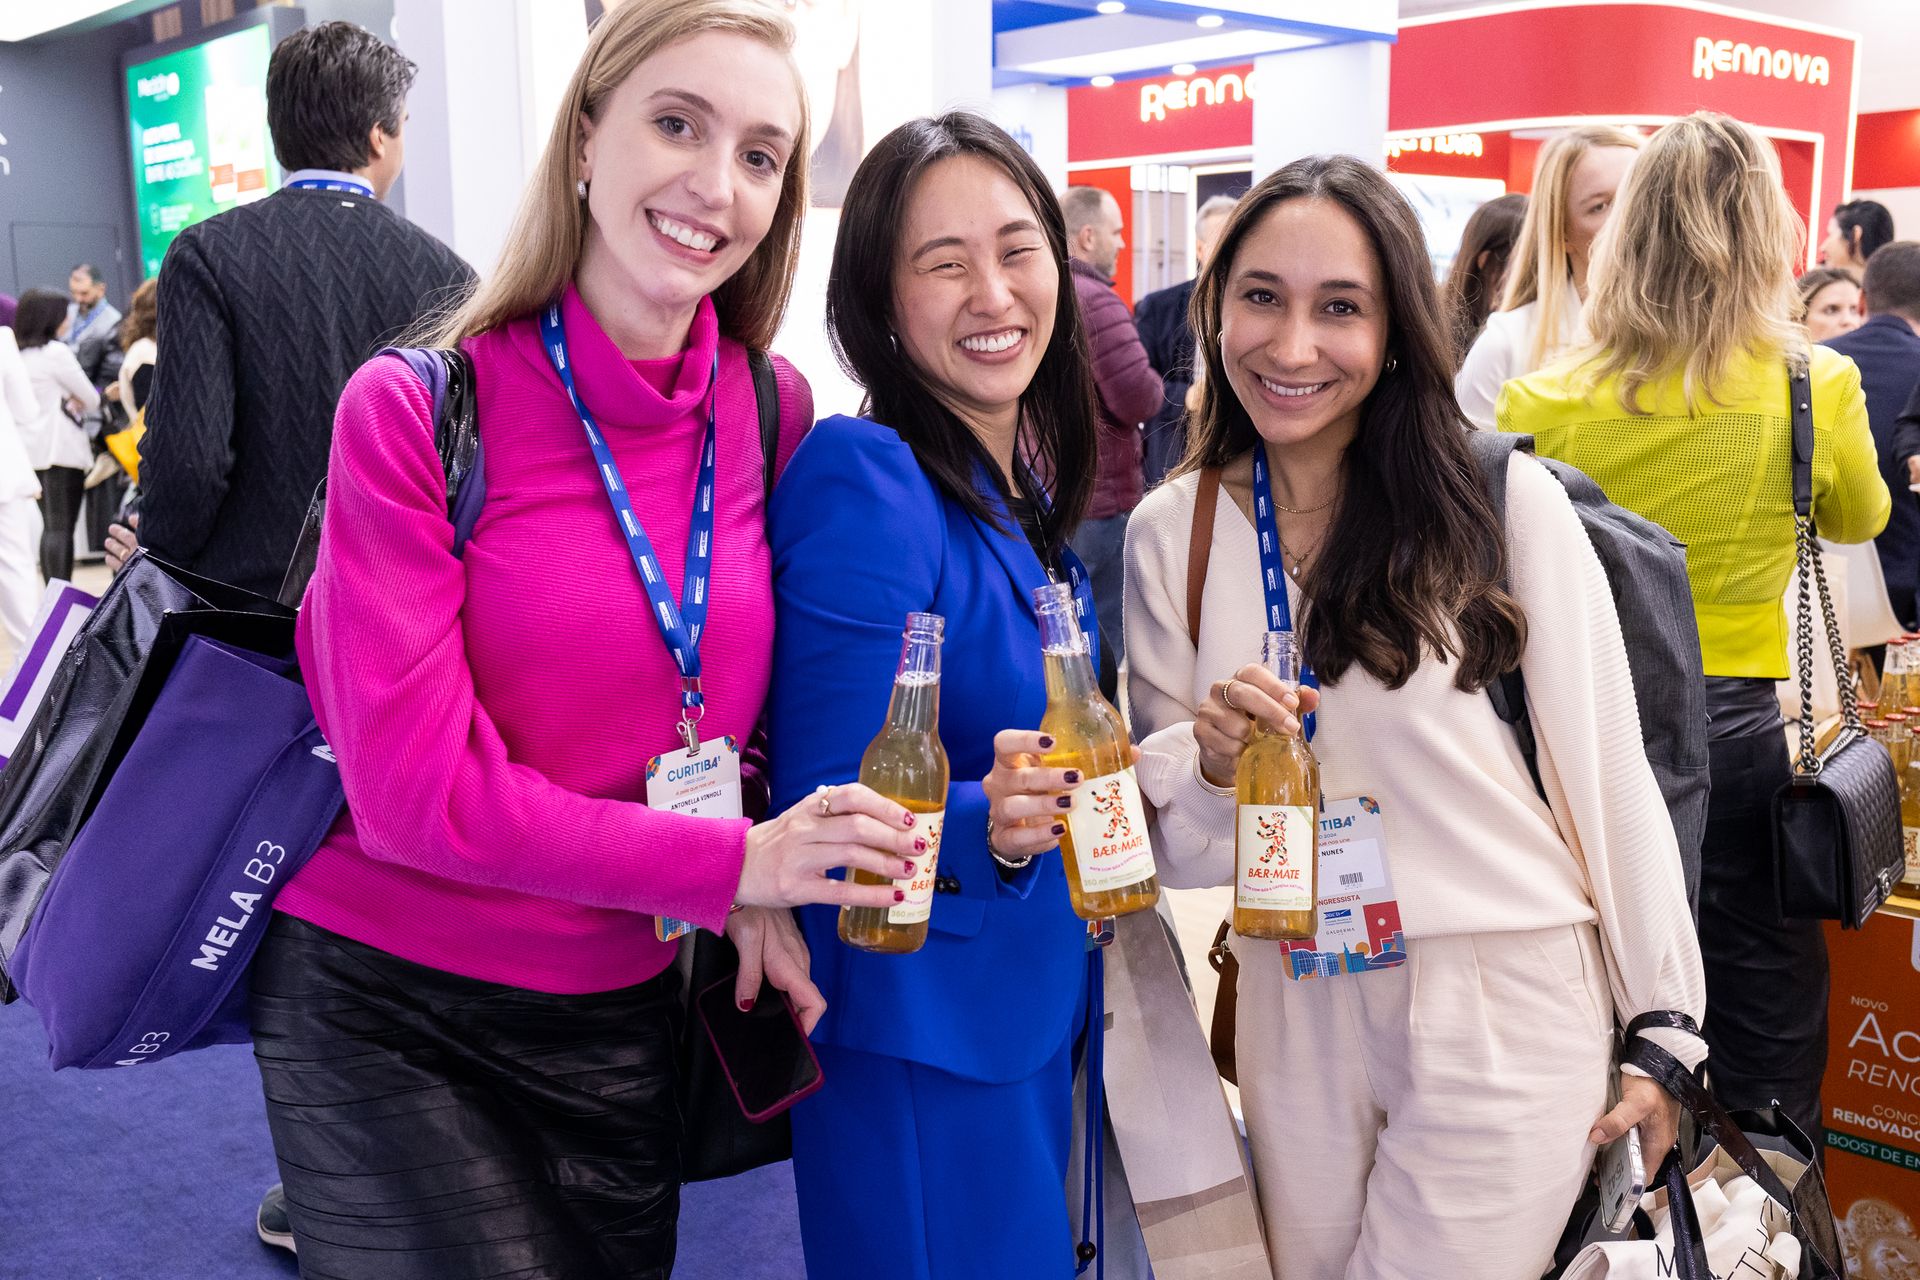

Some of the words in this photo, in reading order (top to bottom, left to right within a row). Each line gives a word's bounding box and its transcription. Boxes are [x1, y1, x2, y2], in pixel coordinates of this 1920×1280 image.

[1692, 36, 1830, 86] RENNOVA
[1321, 847, 1344, 857] NUNES
[1247, 867, 1300, 879] BÆR-MATE
[190, 891, 263, 971] MELA
[243, 840, 286, 885] B3
[1316, 894, 1361, 907] NGRESSISTA
[1850, 996, 1889, 1013] NOVO
[1872, 1104, 1920, 1126] CONC
[1827, 1132, 1877, 1156] BOOST
[1880, 1148, 1901, 1164] DE
